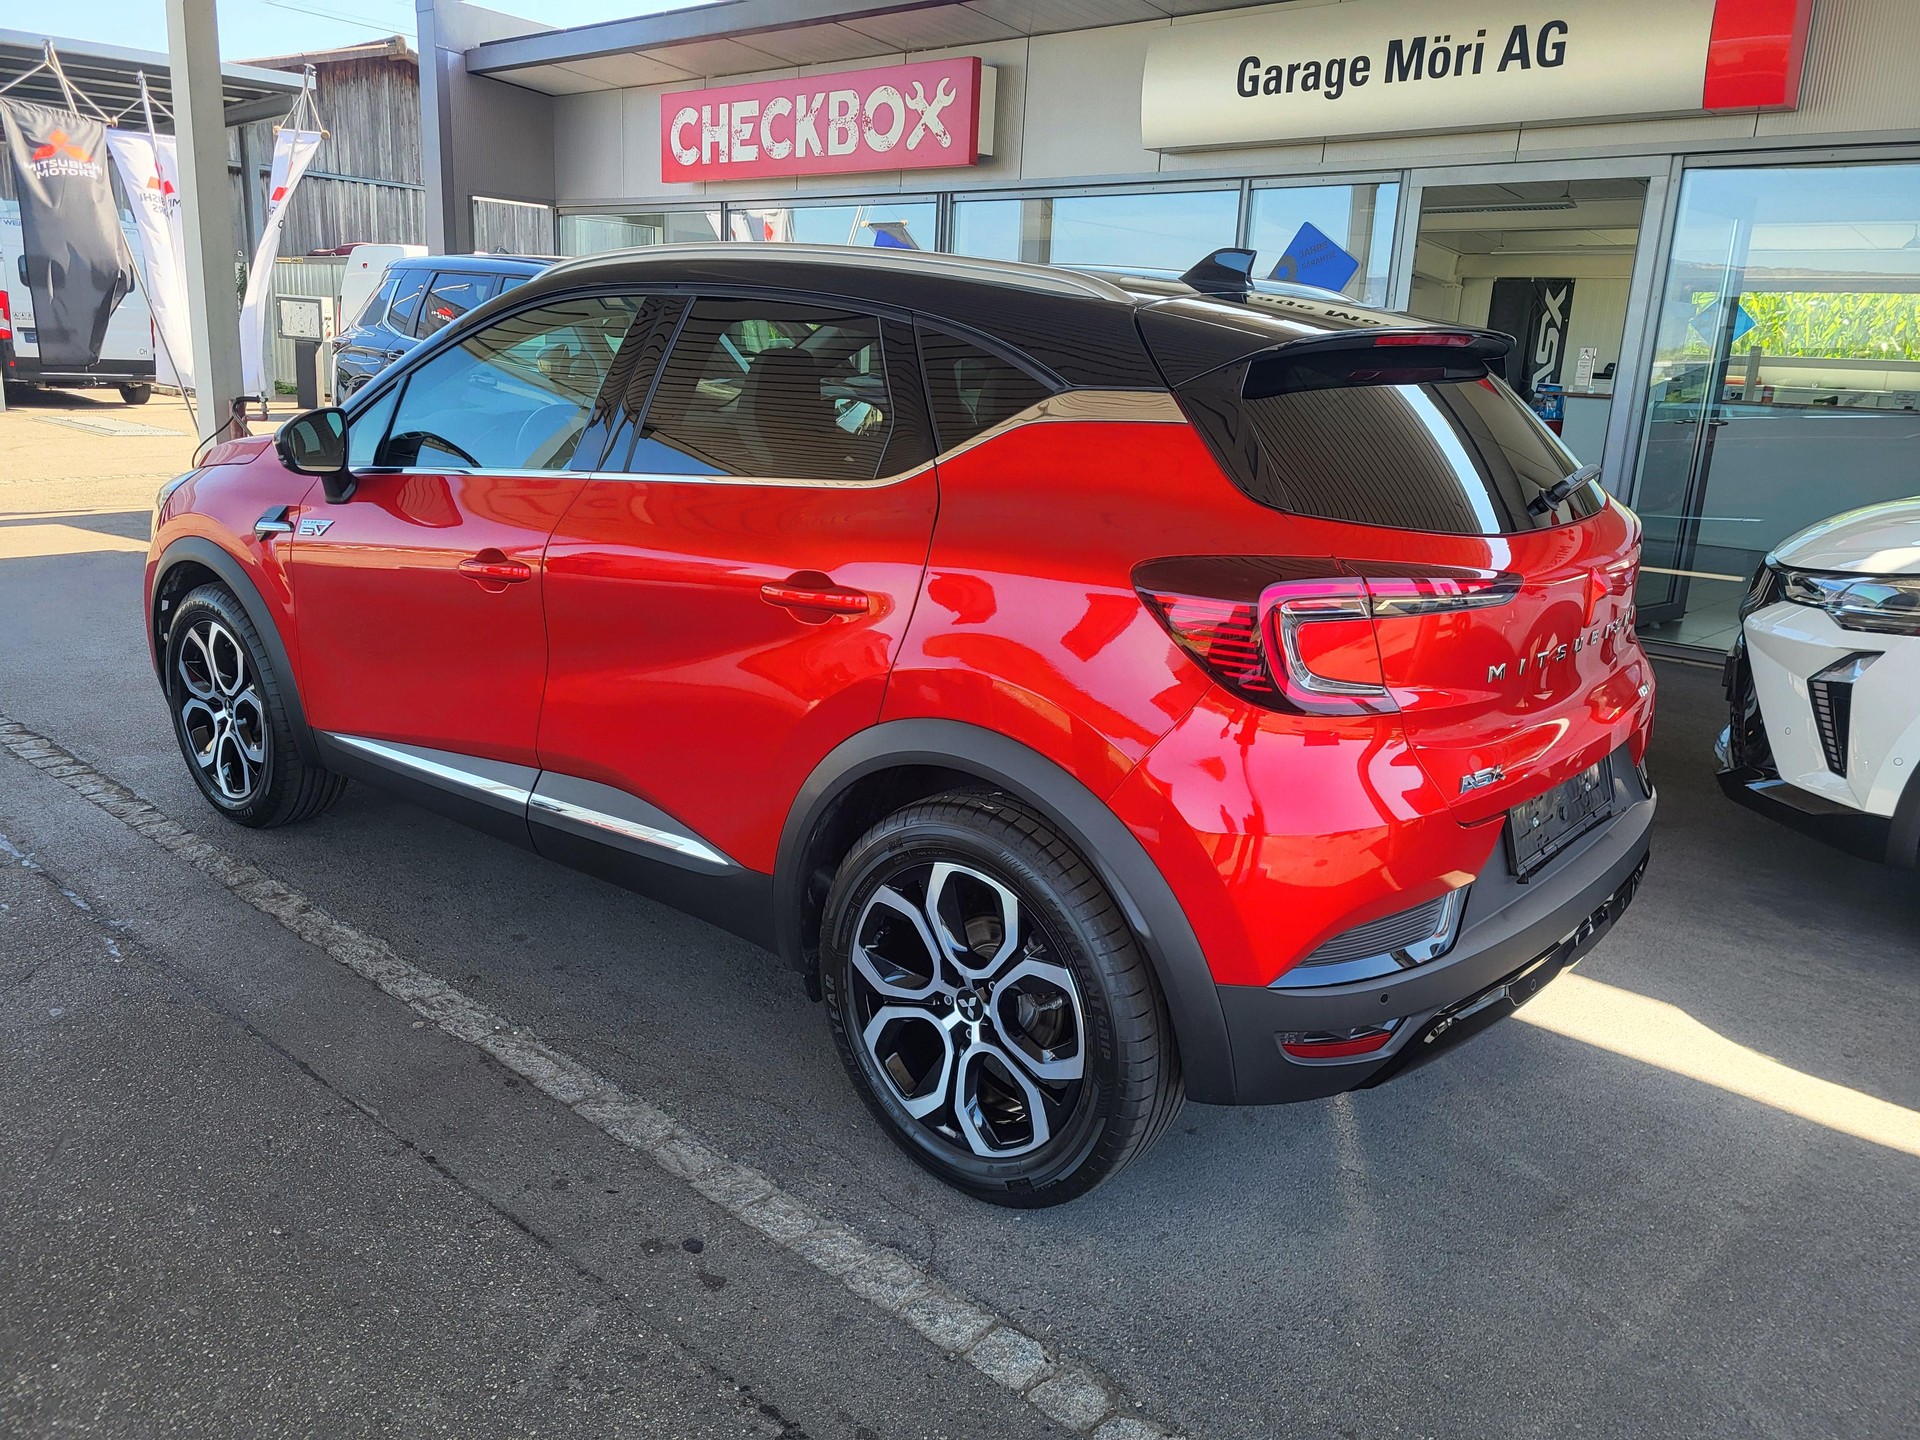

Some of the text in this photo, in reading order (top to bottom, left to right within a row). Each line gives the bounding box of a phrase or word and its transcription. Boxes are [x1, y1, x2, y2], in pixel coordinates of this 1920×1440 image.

[1237, 20, 1568, 100] Garage Möri AG
[669, 76, 956, 167] CHECKBOX
[36, 167, 97, 180] MOTORS
[139, 348, 148, 356] CH
[1487, 604, 1634, 684] MITSUBISHI
[1460, 764, 1506, 794] ASX
